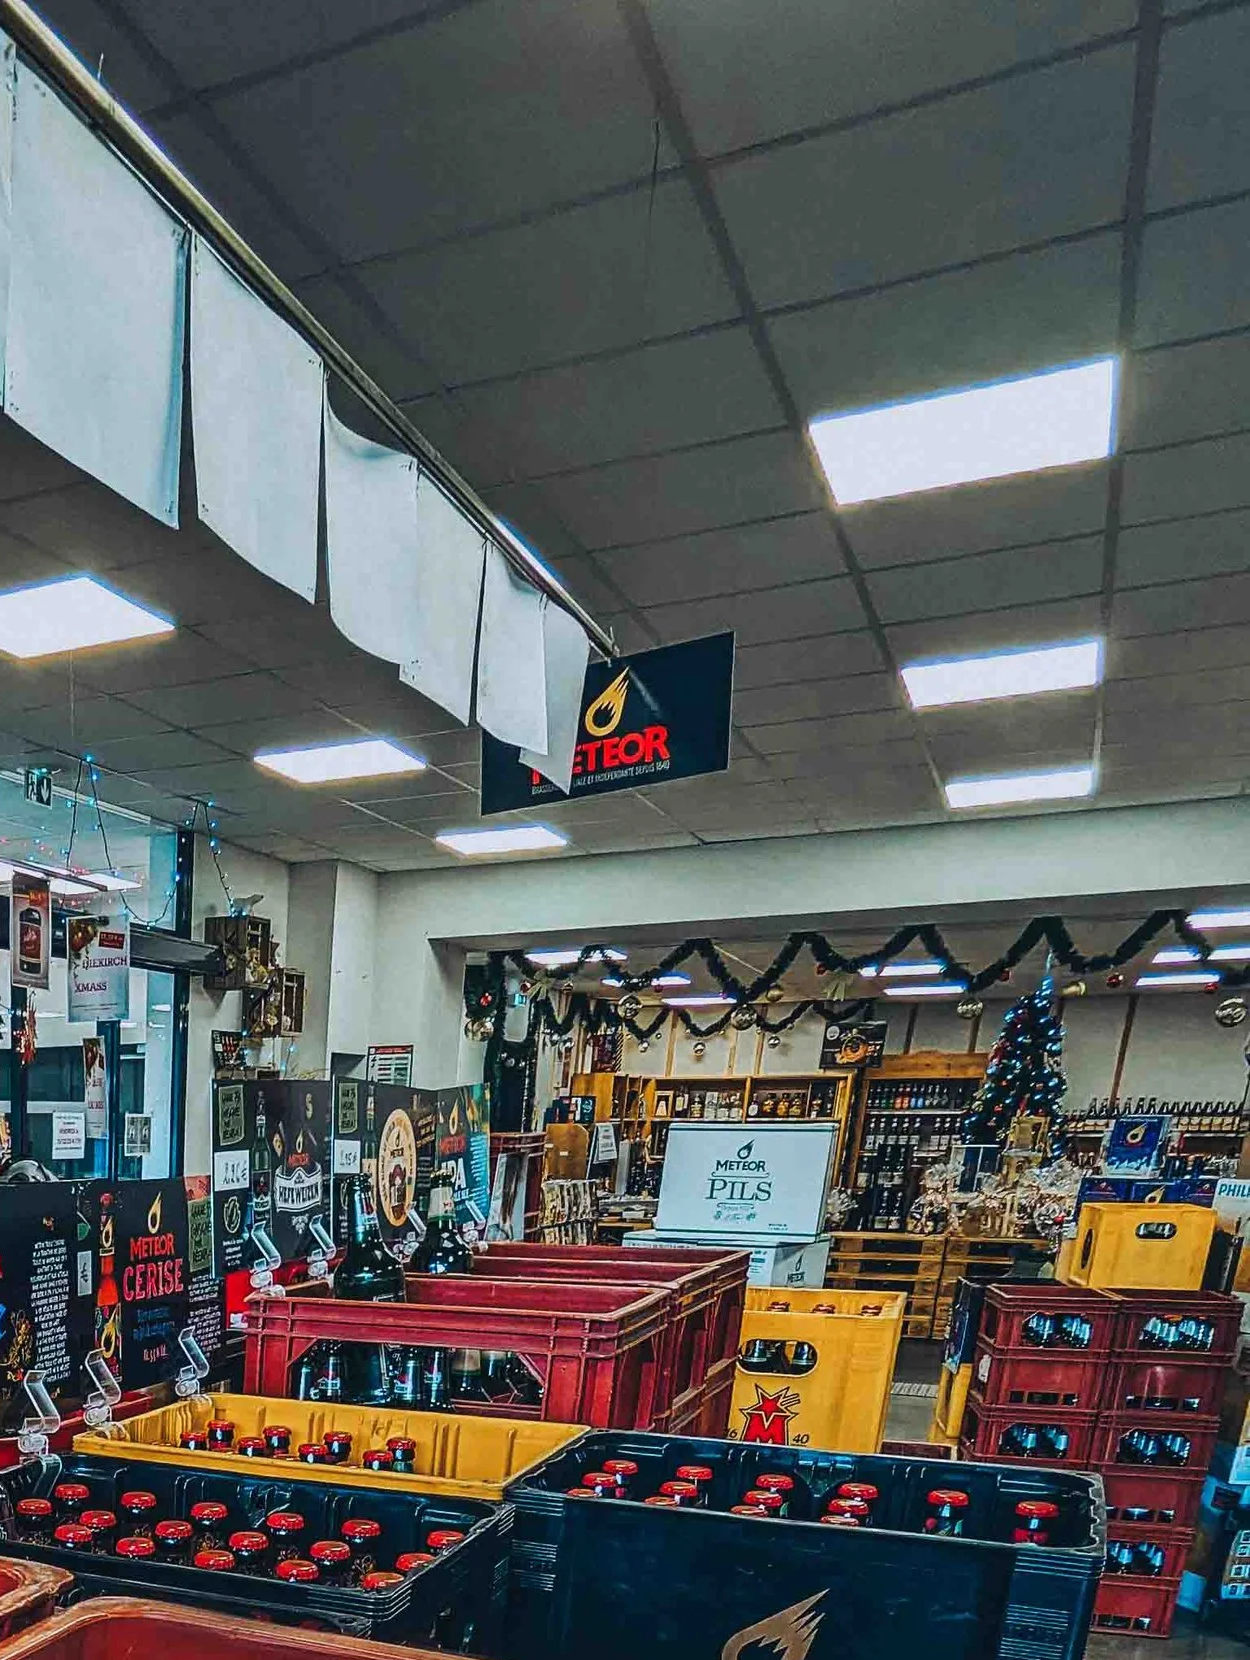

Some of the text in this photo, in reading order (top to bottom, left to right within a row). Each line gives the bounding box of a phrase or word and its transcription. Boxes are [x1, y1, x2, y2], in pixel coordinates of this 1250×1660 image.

[75, 981, 107, 993] XMASS
[716, 1159, 766, 1173] METEOR
[705, 1178, 773, 1202] PILS
[130, 1233, 175, 1261] METEOR
[123, 1258, 184, 1302] CERISE
[792, 1433, 810, 1444] 40
